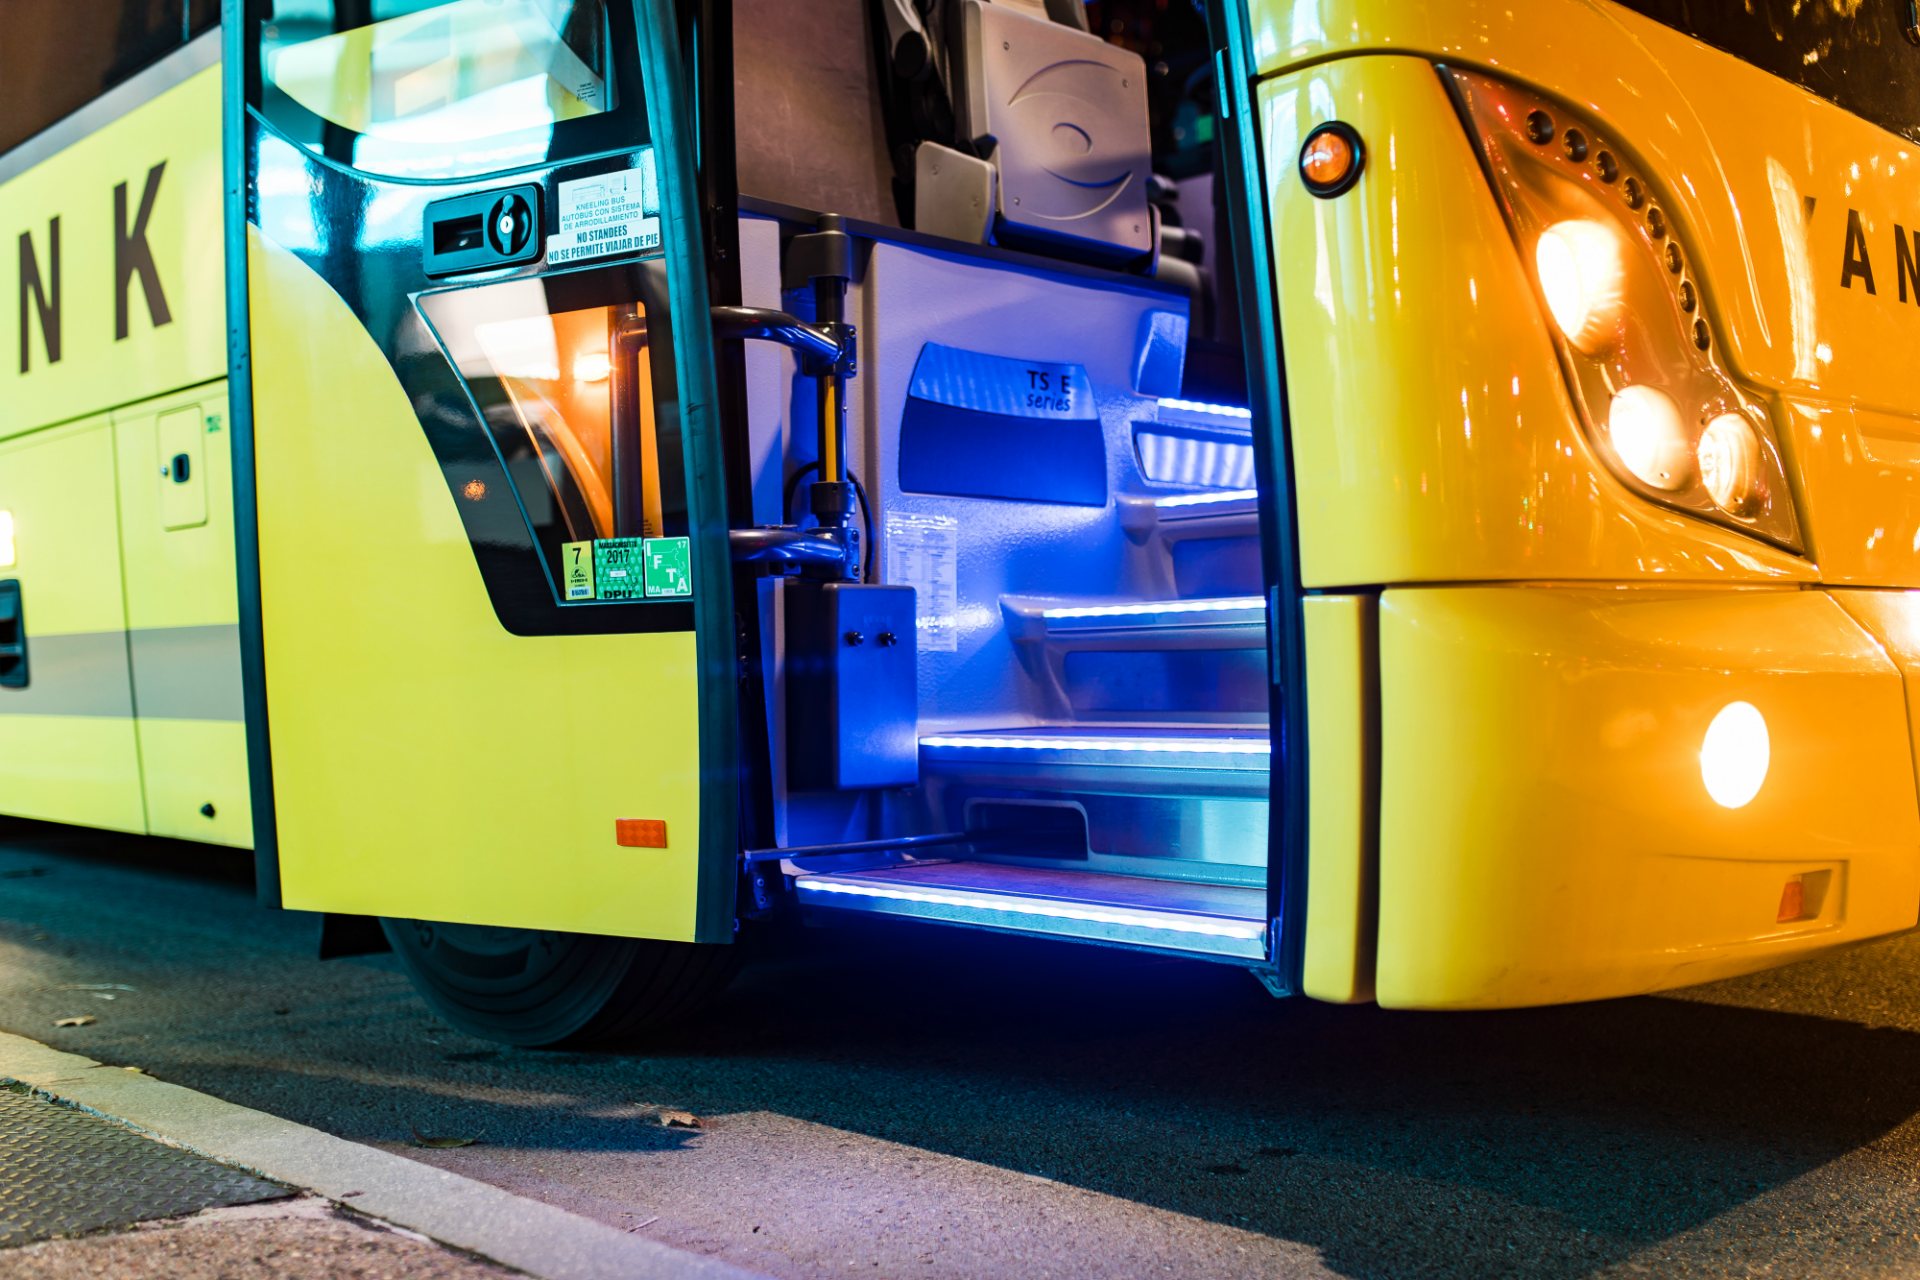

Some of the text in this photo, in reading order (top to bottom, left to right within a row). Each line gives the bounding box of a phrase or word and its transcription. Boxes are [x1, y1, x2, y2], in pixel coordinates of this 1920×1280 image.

[576, 196, 625, 210] KNEELING BUS
[562, 202, 640, 222] AUTOBUS CON SISTEMA
[575, 211, 638, 228] ARRODILLAMIENTO
[577, 225, 627, 243] NO STANDEES
[549, 233, 658, 261] NO SE PERMITE VIAJAR DE PIE
[1027, 370, 1071, 395] TS E
[1027, 393, 1071, 411] series
[676, 540, 687, 549] 17
[572, 547, 581, 565] 7
[607, 549, 630, 563] 2017
[604, 590, 632, 598] DPU
[647, 585, 661, 593] MA
